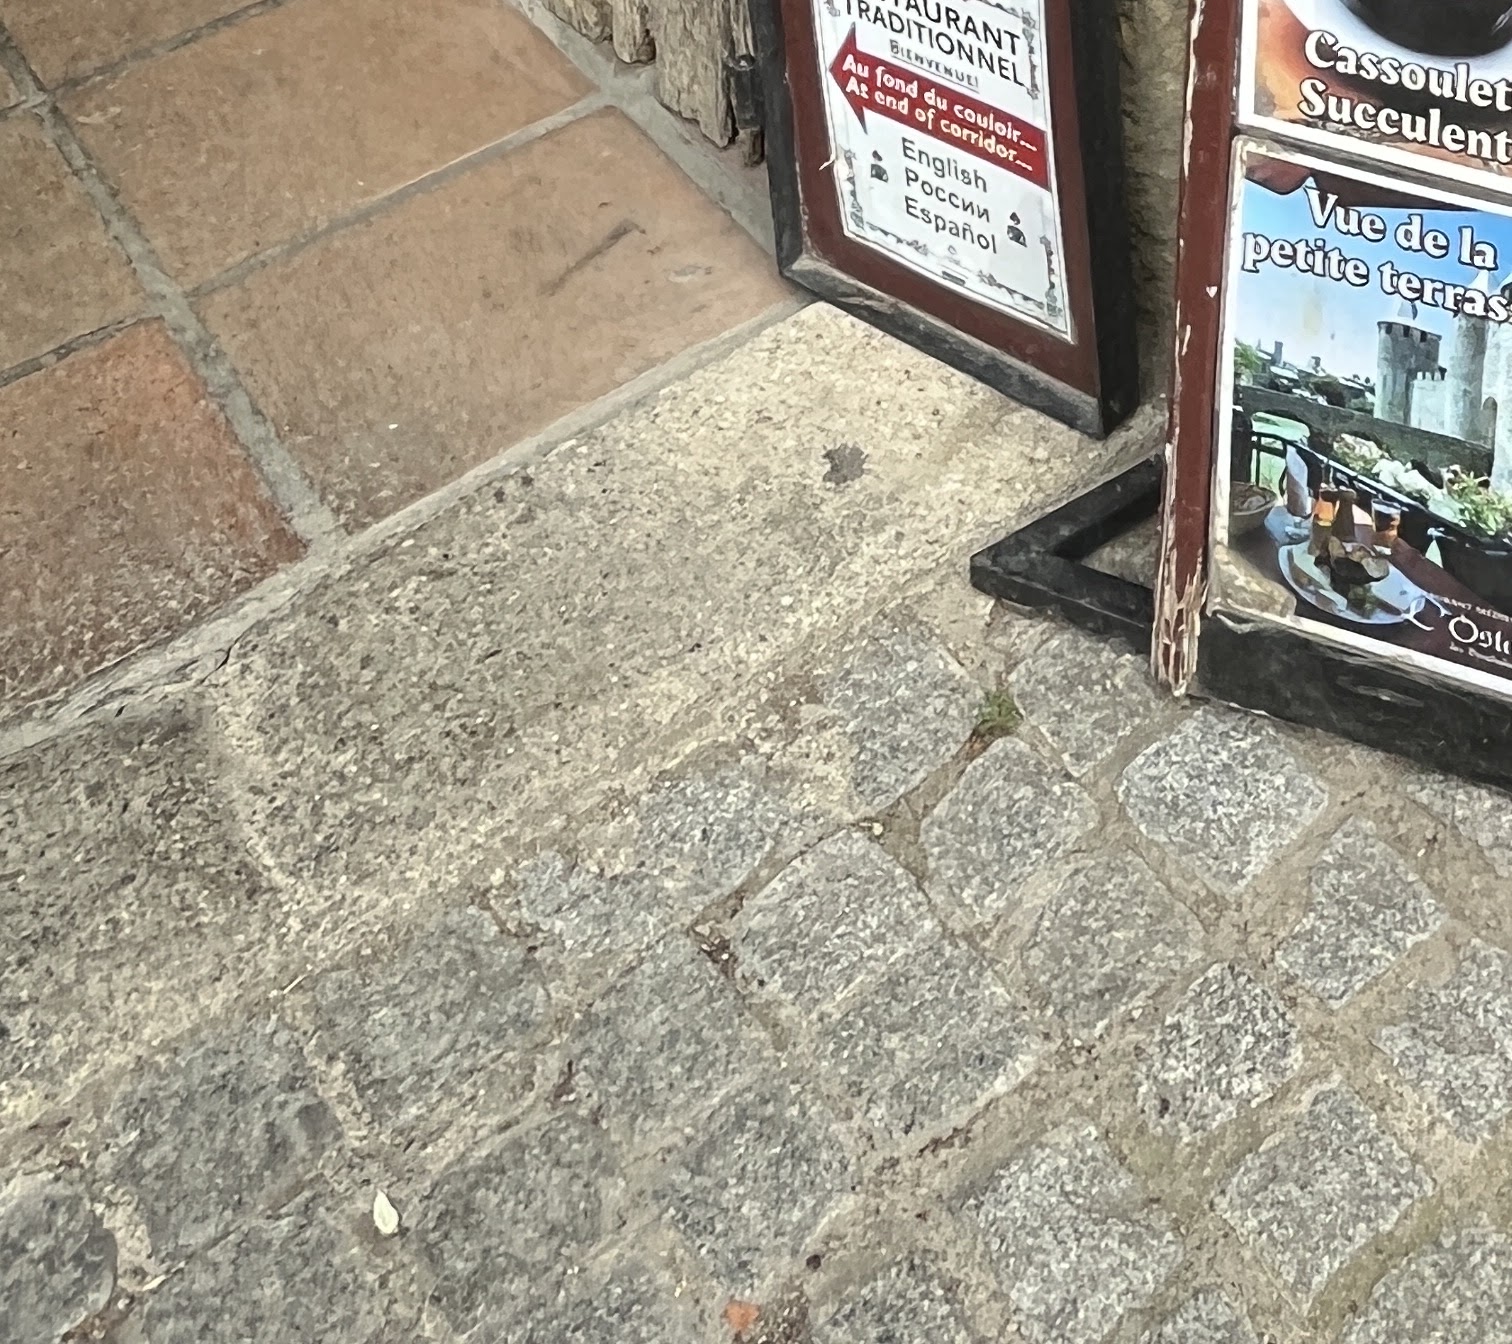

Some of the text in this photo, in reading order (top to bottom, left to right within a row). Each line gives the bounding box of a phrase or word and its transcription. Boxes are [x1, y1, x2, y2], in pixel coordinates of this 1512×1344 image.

[843, 54, 869, 78] Au
[875, 66, 918, 98] fond
[924, 88, 948, 111] du
[874, 90, 909, 115] end
[915, 108, 936, 130] of
[901, 137, 987, 193] English
[905, 195, 997, 254] Español
[1302, 183, 1498, 270] Vue de la
[1242, 231, 1370, 286] petite
